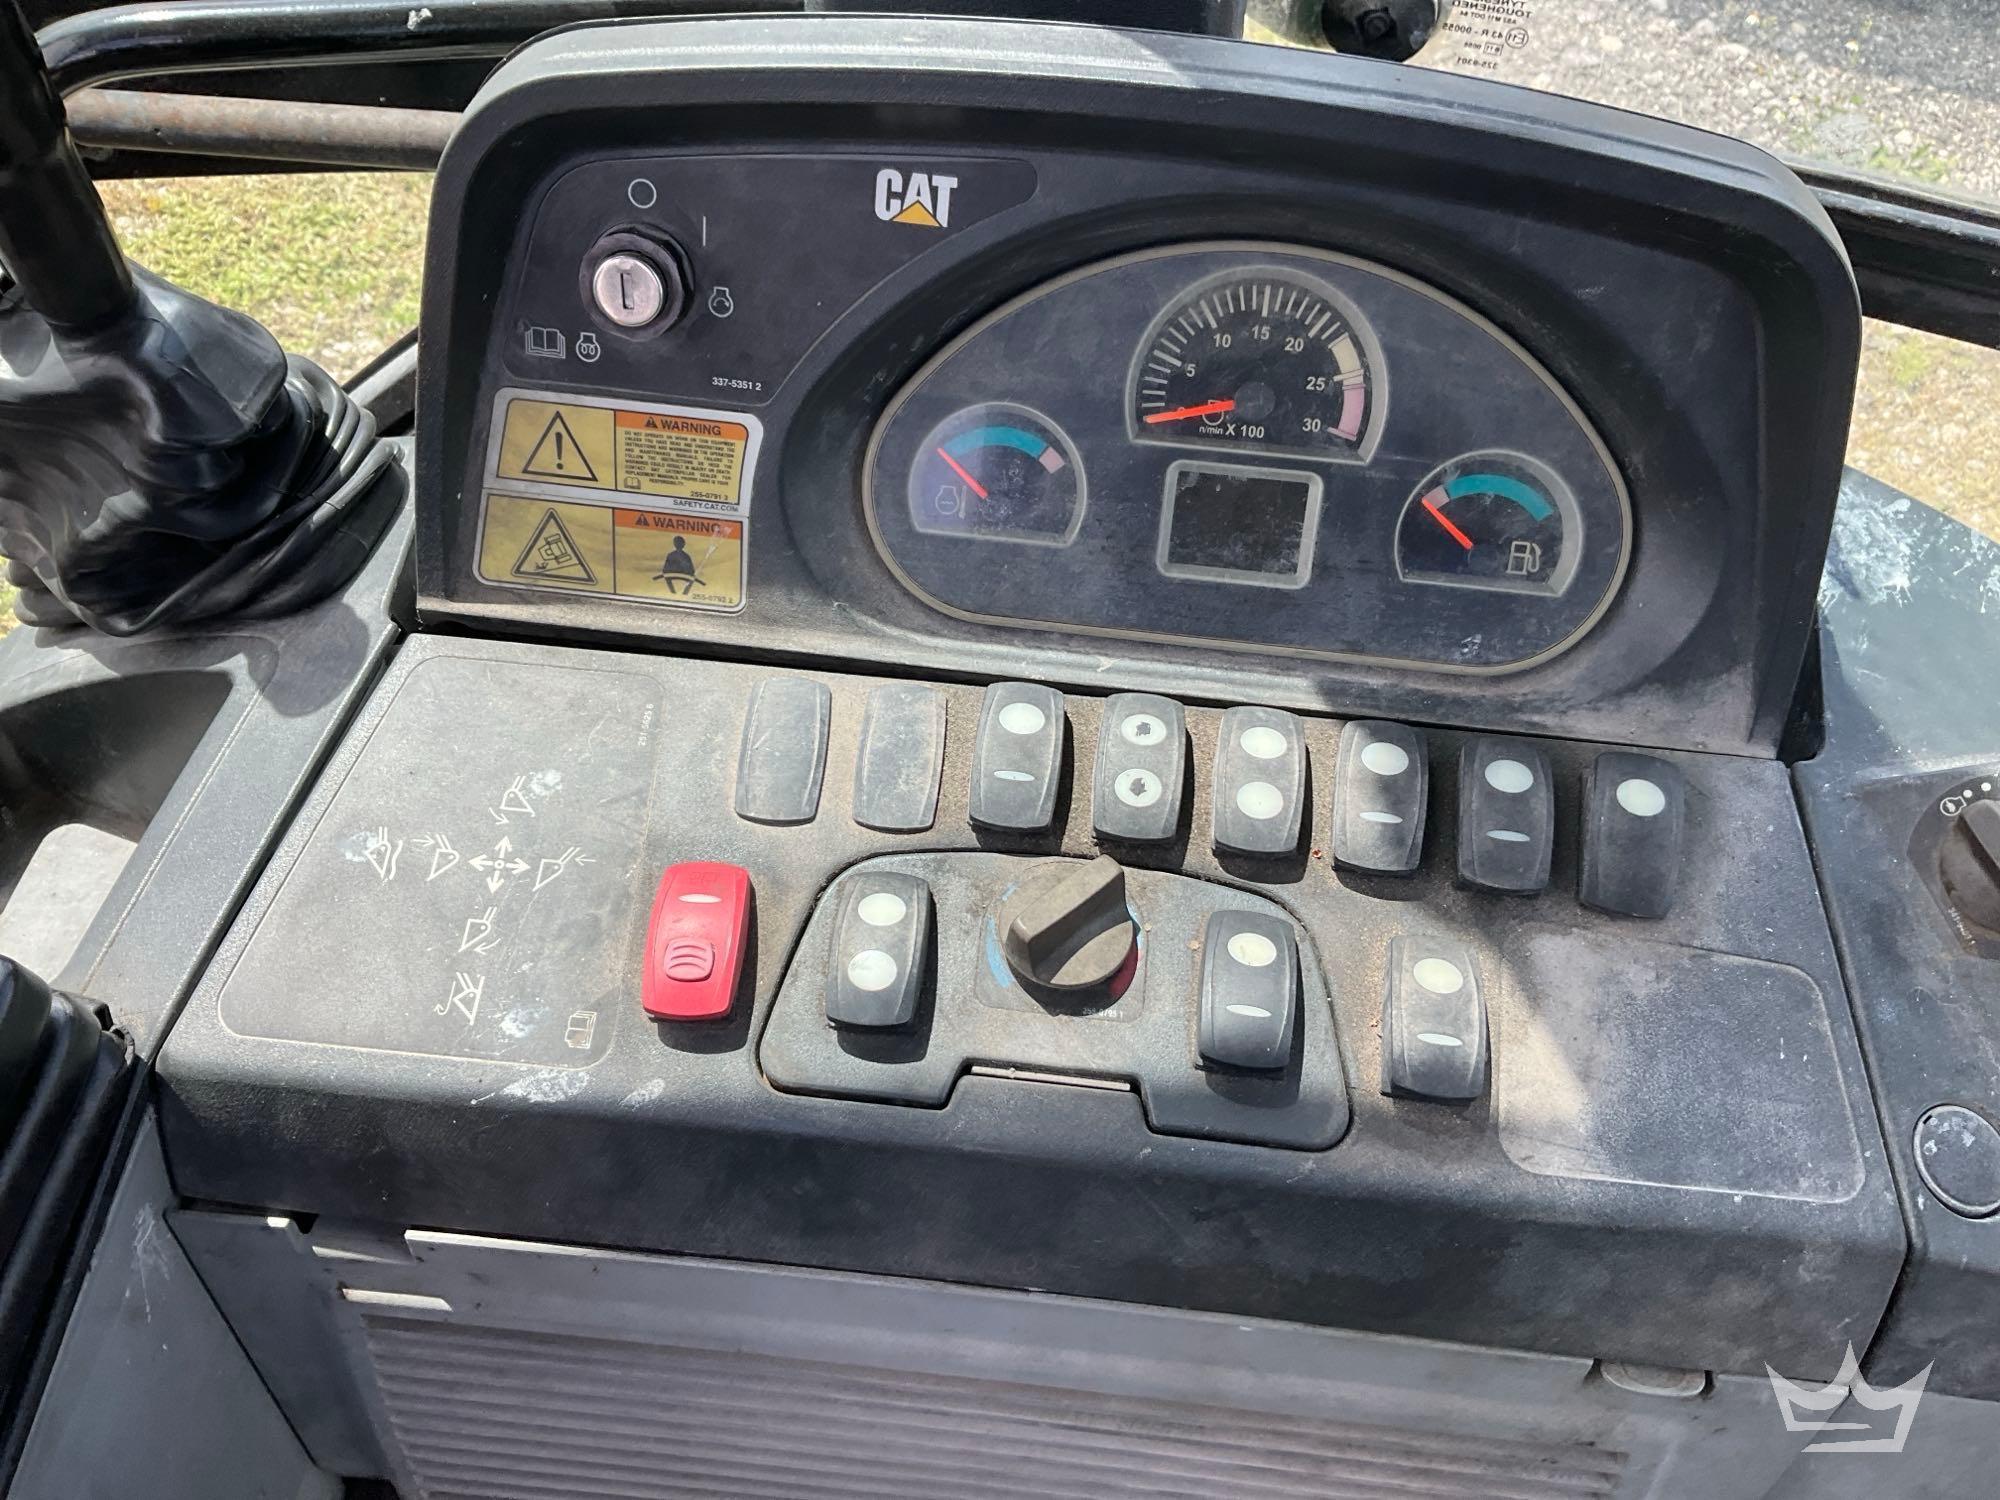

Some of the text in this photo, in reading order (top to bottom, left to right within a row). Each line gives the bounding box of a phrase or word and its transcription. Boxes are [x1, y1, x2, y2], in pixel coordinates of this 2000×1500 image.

[874, 168, 958, 228] CAT
[1213, 334, 1232, 348] 10
[1252, 326, 1271, 341] 15
[1284, 337, 1304, 352] 20
[1185, 364, 1196, 378] 5
[712, 376, 753, 390] 337-5351
[1305, 377, 1326, 391] 25
[660, 419, 721, 436] WARNING
[1240, 426, 1265, 438] 100
[1302, 418, 1321, 433] 30
[652, 516, 721, 534] WARNING
